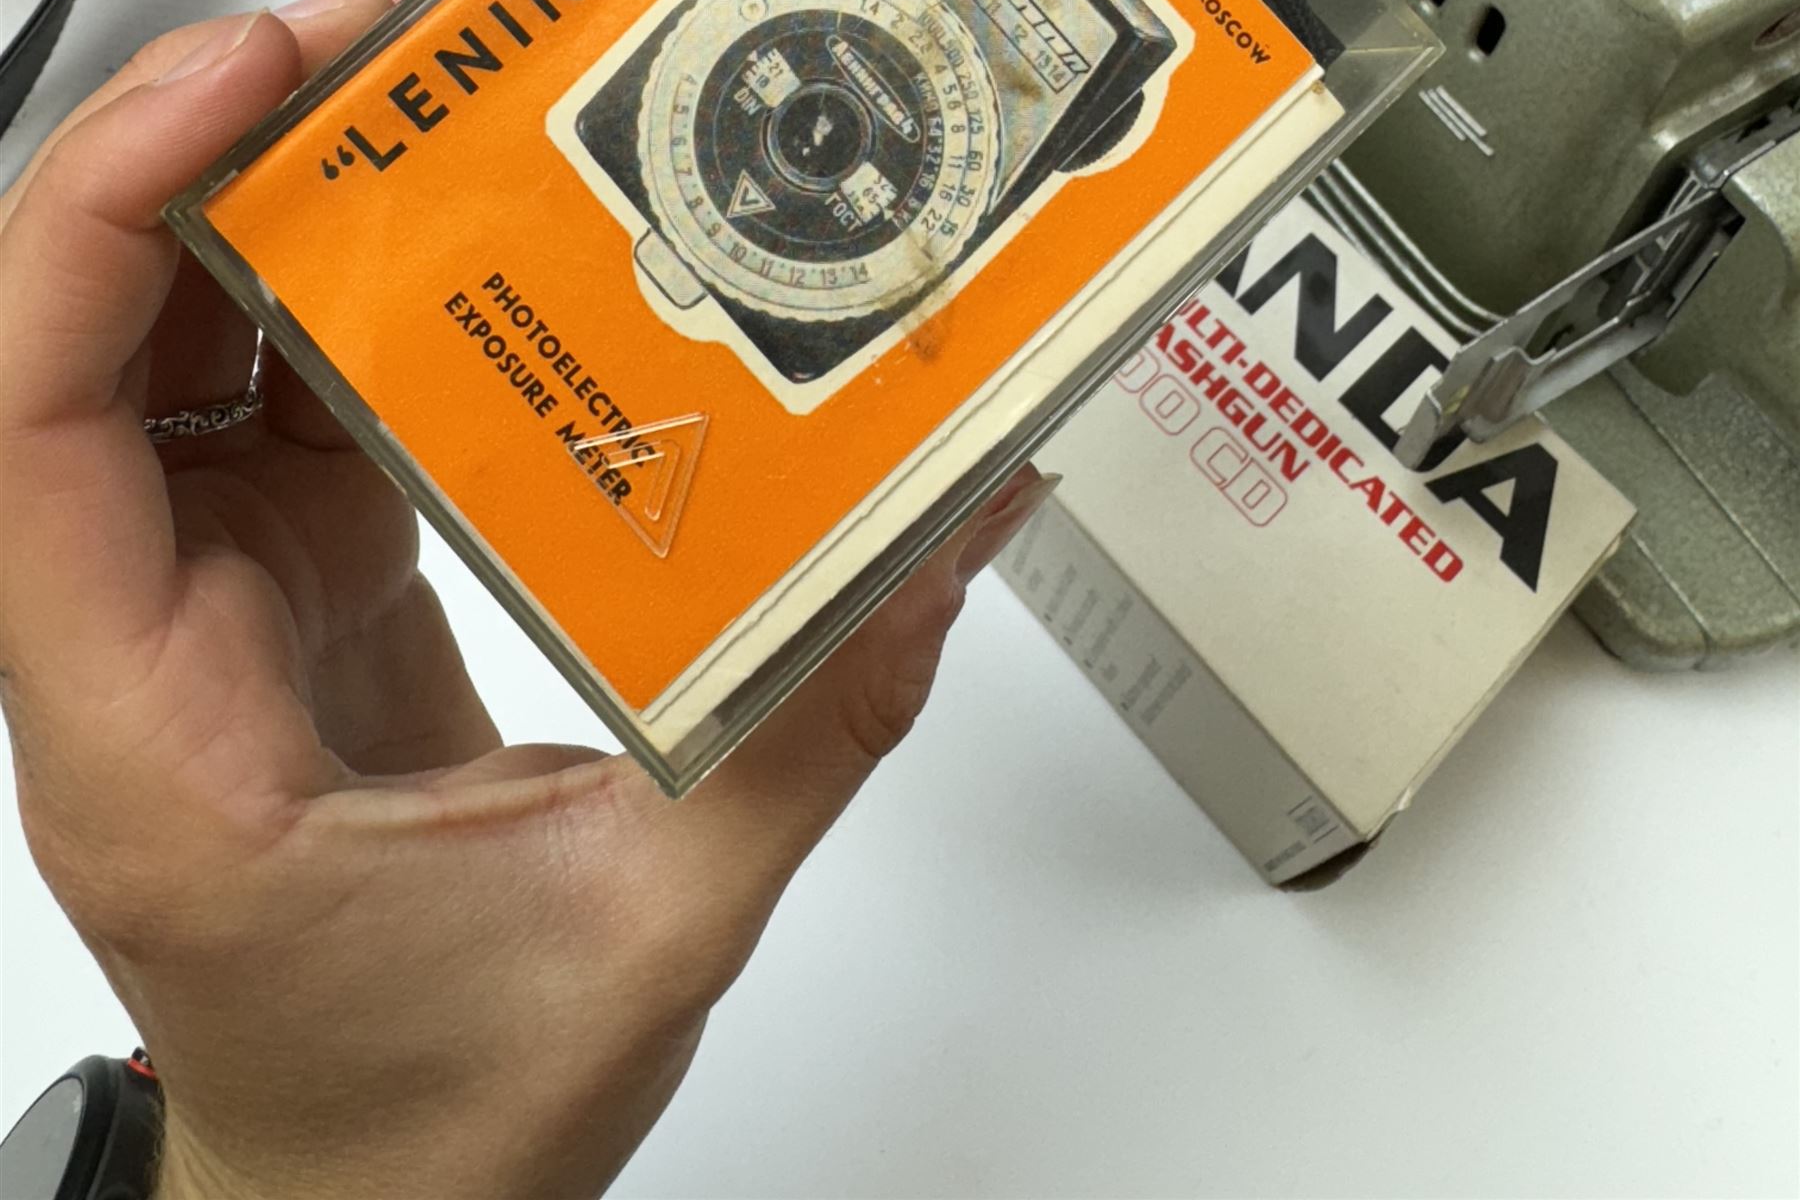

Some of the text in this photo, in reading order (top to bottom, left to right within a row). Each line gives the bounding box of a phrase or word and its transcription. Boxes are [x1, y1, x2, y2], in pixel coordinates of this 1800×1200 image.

[734, 87, 762, 116] DIN
[921, 208, 942, 232] 22
[444, 291, 632, 506] EXPOSURE METER
[482, 272, 656, 468] PHOTOELECTRIC
[1214, 232, 1559, 593] NDA
[1190, 426, 1288, 527] CD
